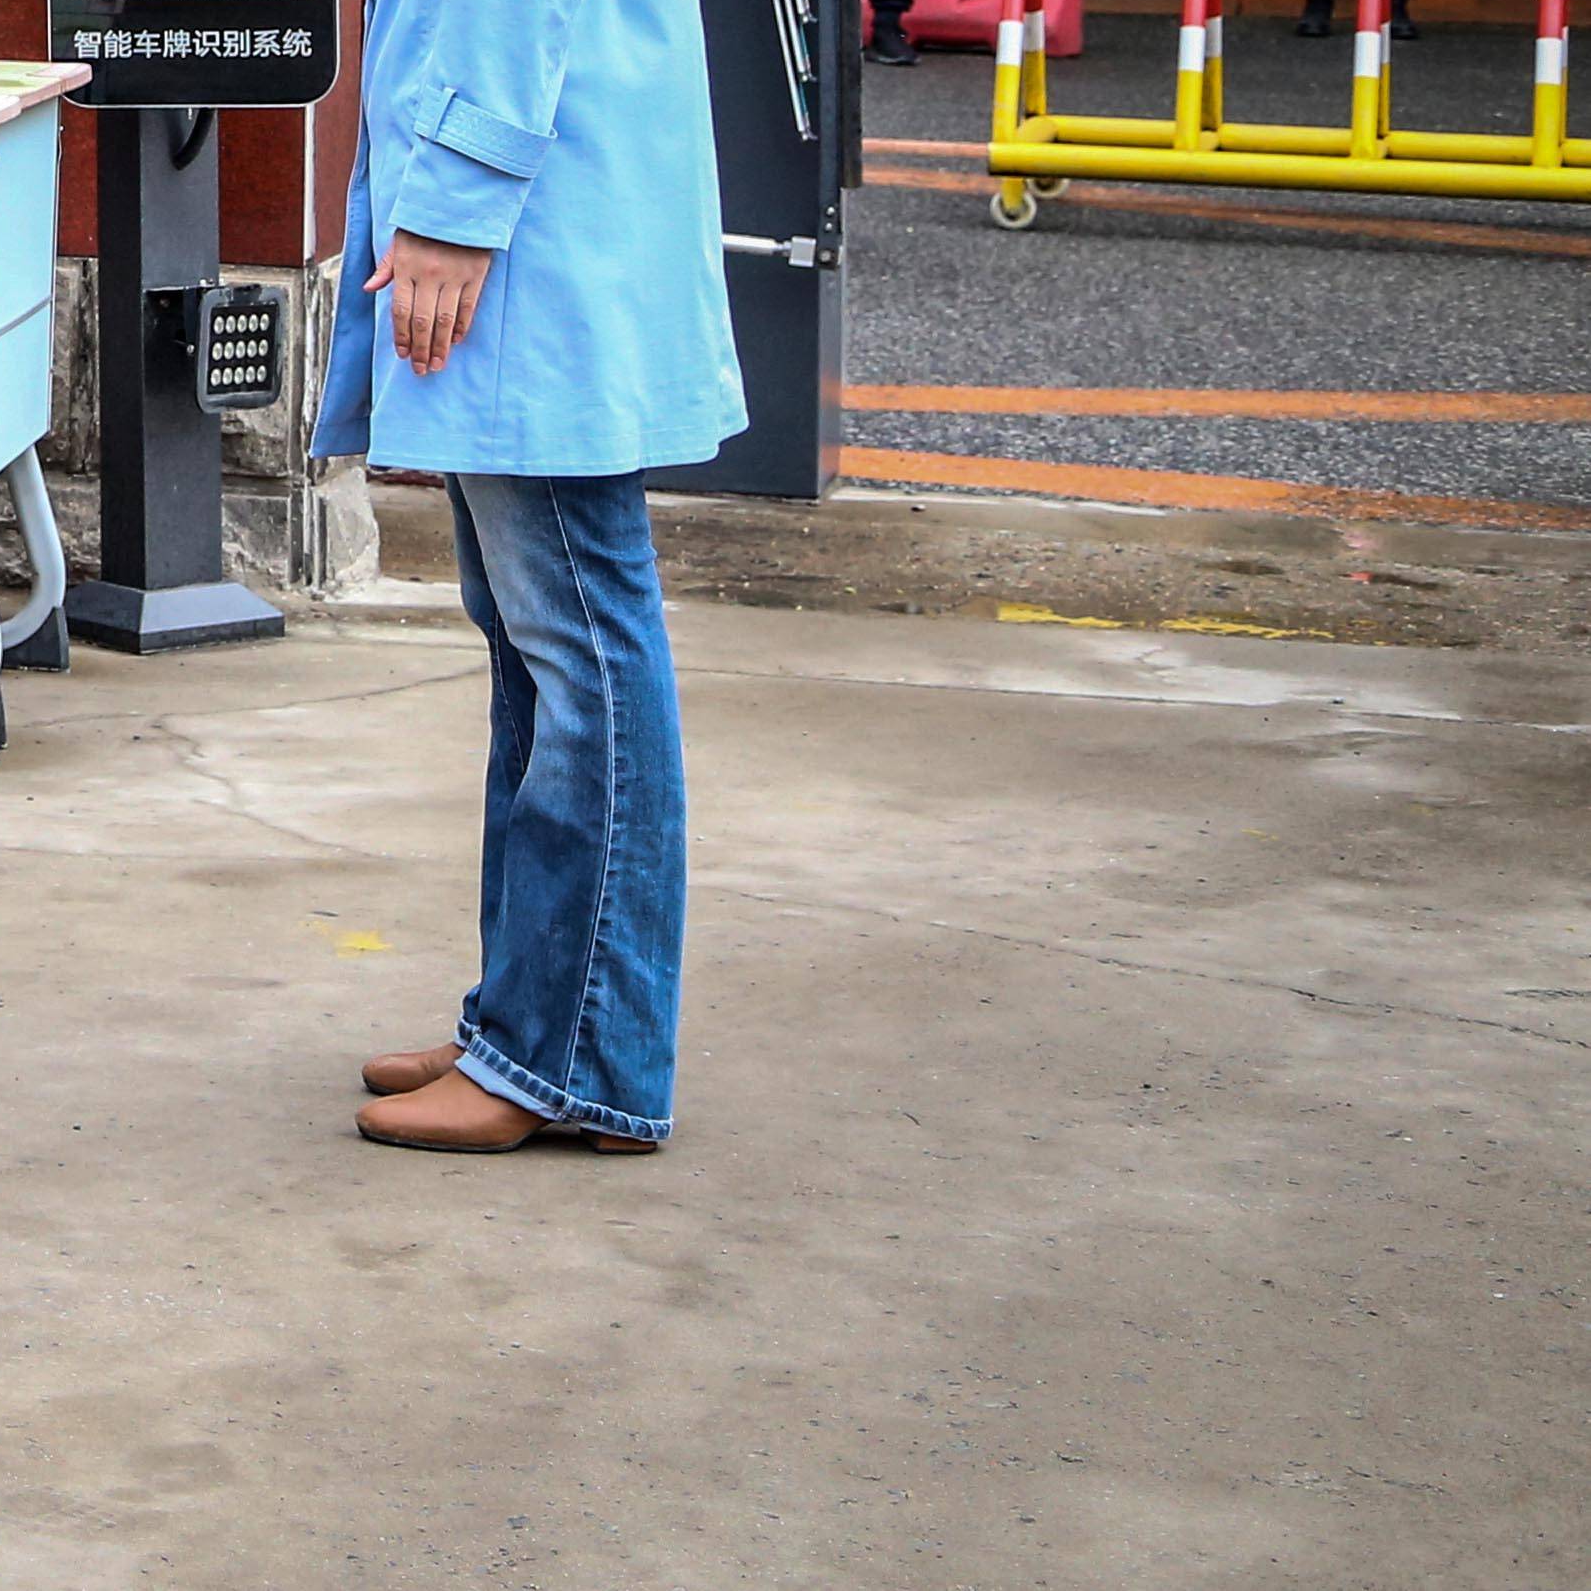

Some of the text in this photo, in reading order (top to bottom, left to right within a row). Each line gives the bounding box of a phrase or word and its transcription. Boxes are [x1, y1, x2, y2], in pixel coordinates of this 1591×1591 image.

[73, 29, 313, 60] 智能车牌识别系统
